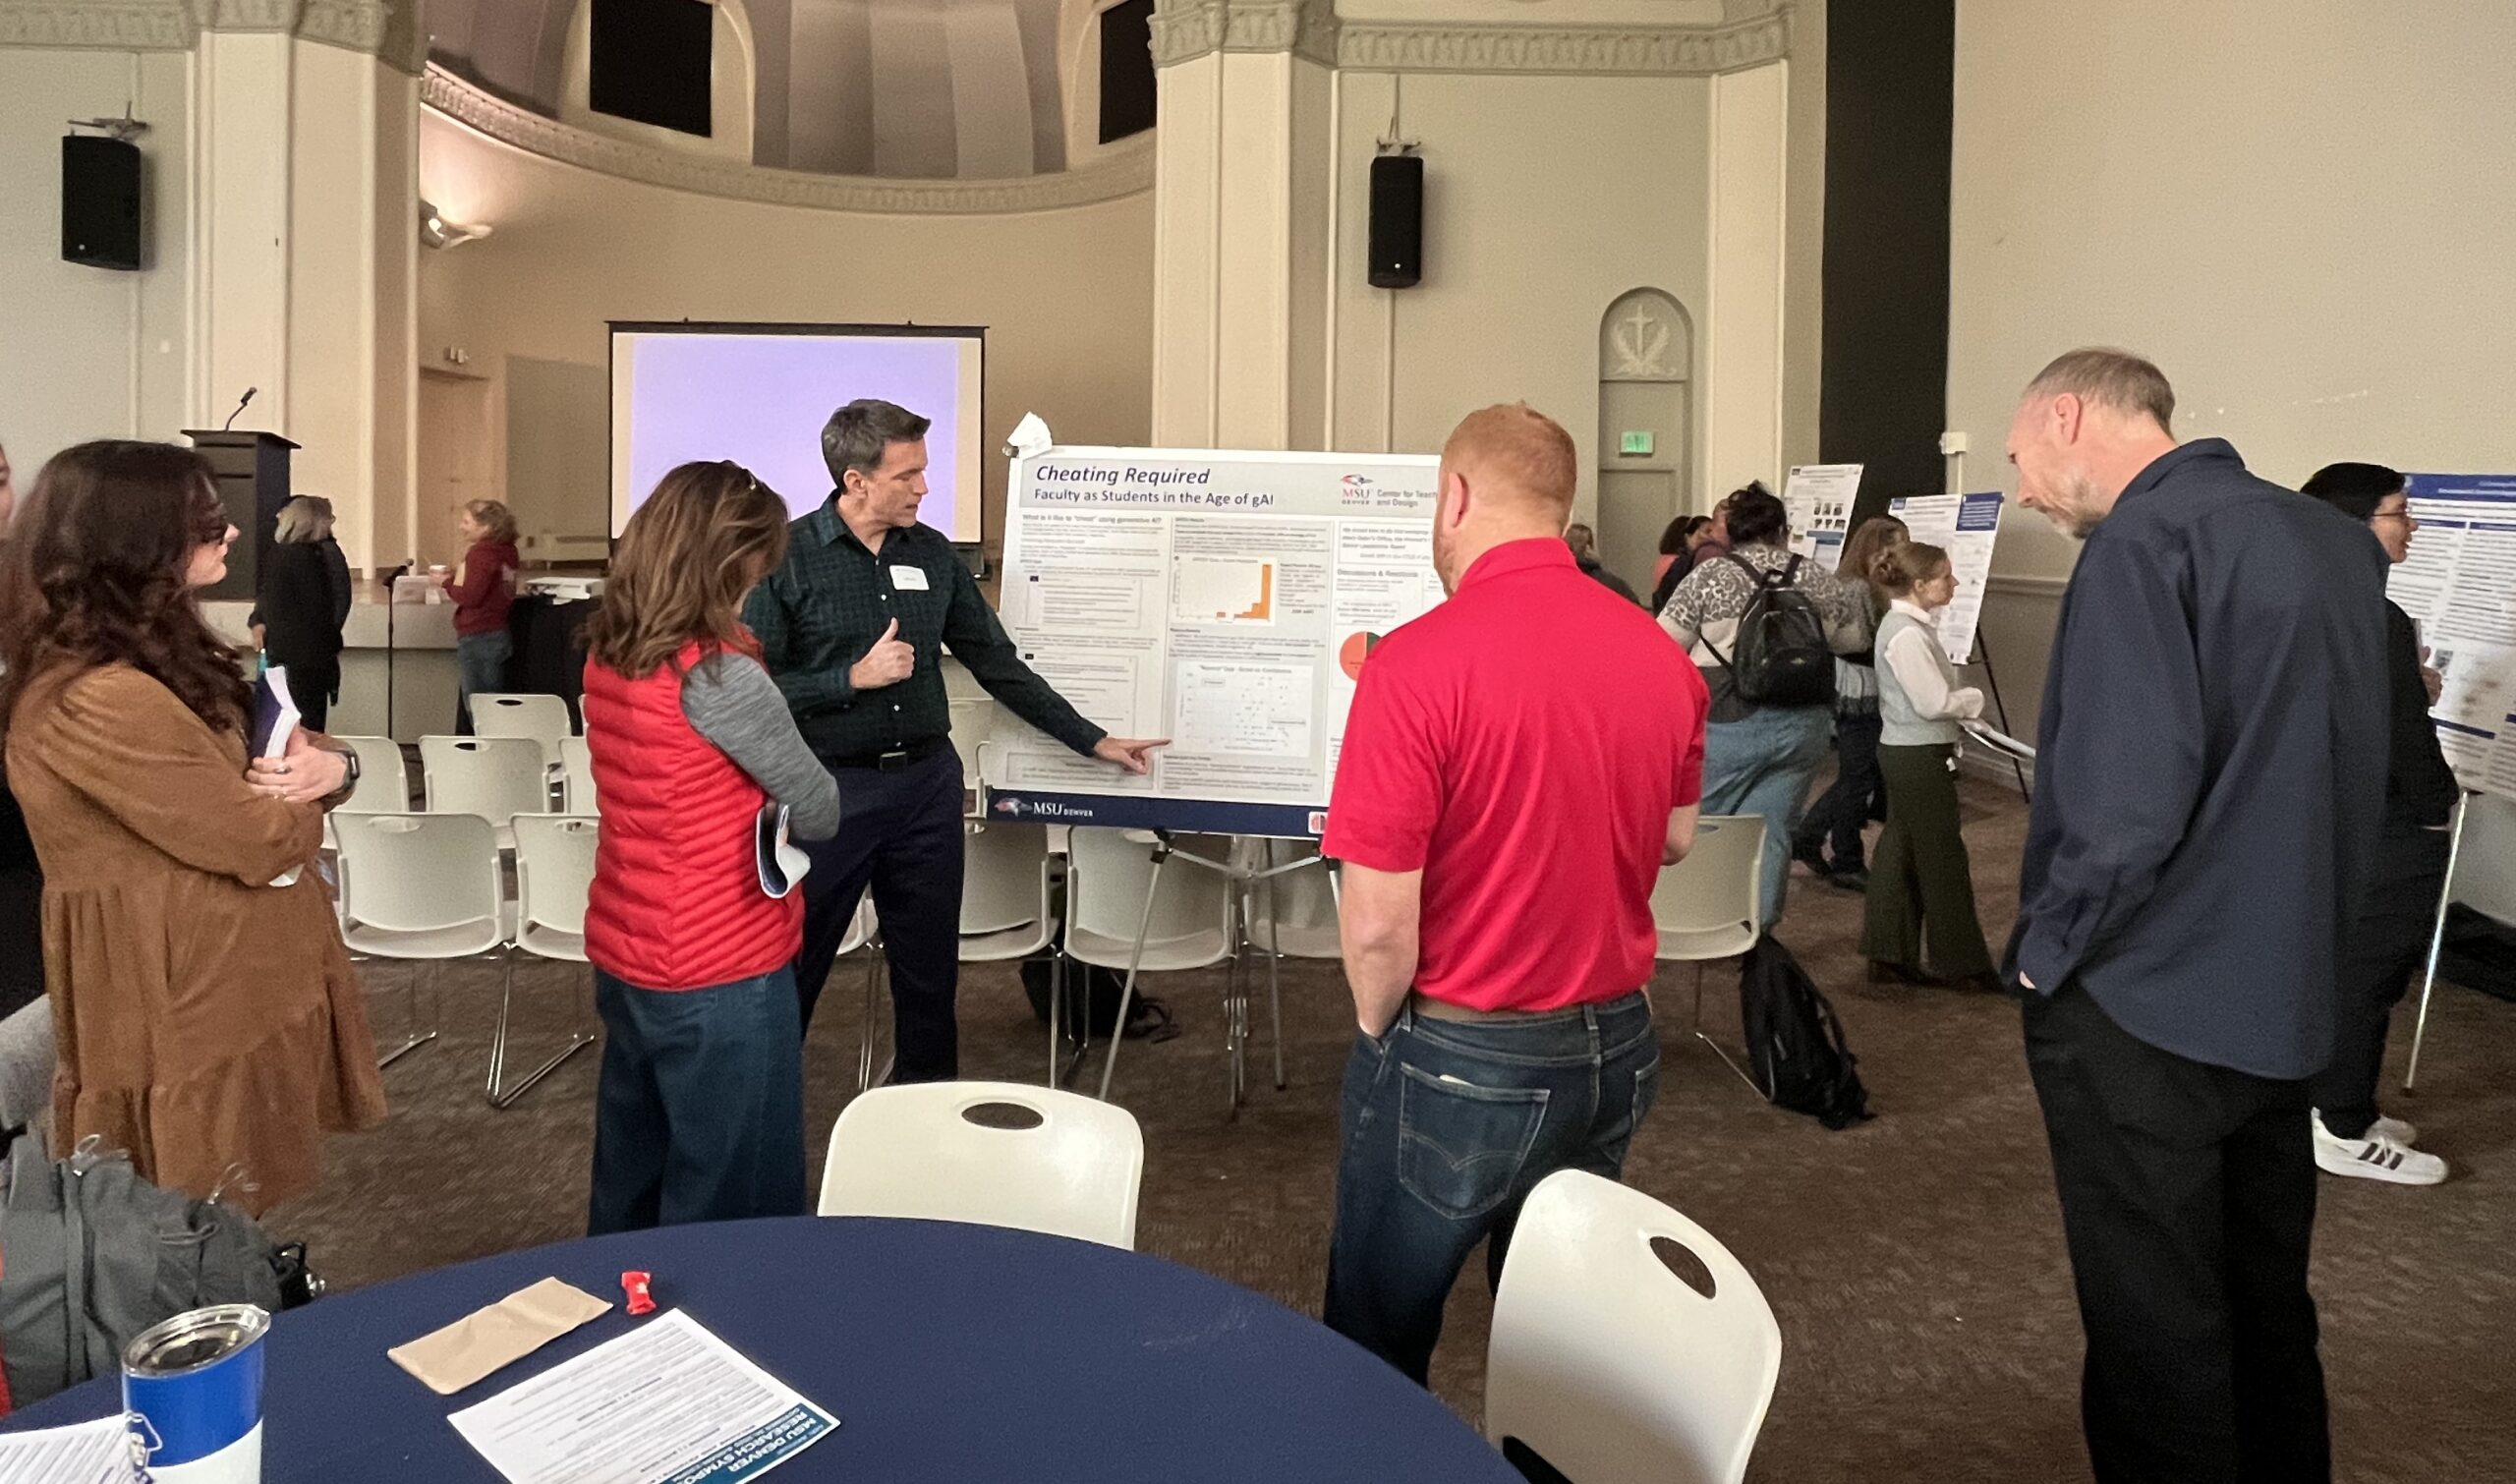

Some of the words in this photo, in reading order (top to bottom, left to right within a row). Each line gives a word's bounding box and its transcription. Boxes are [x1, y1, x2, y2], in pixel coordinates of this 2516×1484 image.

[1036, 465, 1119, 485] Cheating
[1124, 468, 1210, 487] Required
[1034, 488, 1080, 503] Faculty
[1084, 492, 1098, 502] as
[1101, 489, 1160, 503] Students
[1164, 492, 1175, 503] in
[1179, 491, 1201, 504] the
[1205, 492, 1229, 506] Age
[1234, 492, 1250, 505] of
[1252, 493, 1274, 508] gAI
[1343, 488, 1370, 499] MSU
[1033, 801, 1062, 816] MSU
[734, 1411, 808, 1455] RESEARCH
[785, 1417, 817, 1441] MSU
[727, 1437, 786, 1472] DENVER
